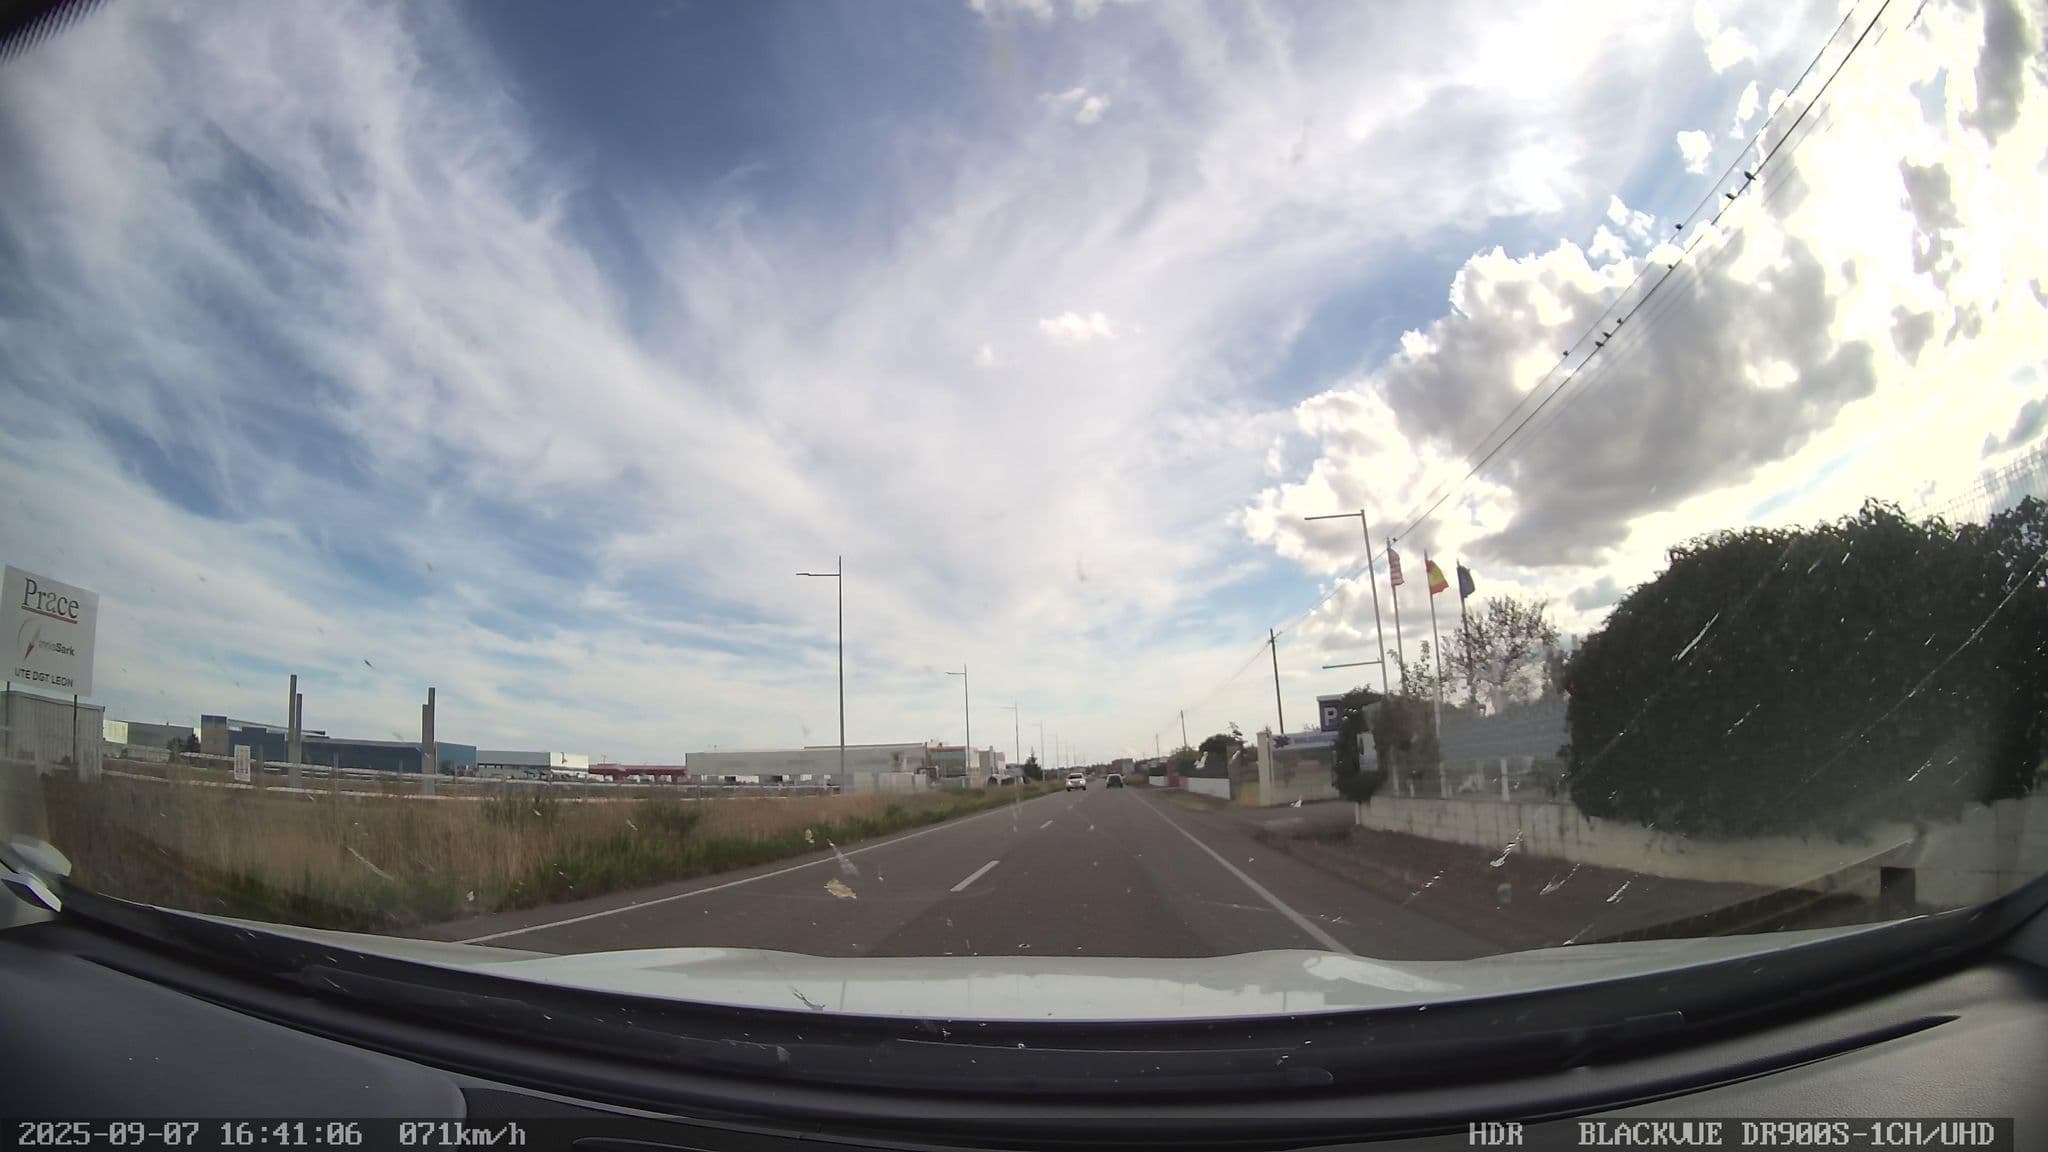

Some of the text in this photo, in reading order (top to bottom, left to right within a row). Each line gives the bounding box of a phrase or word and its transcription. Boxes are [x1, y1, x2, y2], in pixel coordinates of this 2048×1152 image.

[22, 578, 79, 618] Prace
[15, 667, 31, 680] UTE
[32, 671, 50, 682] DGT
